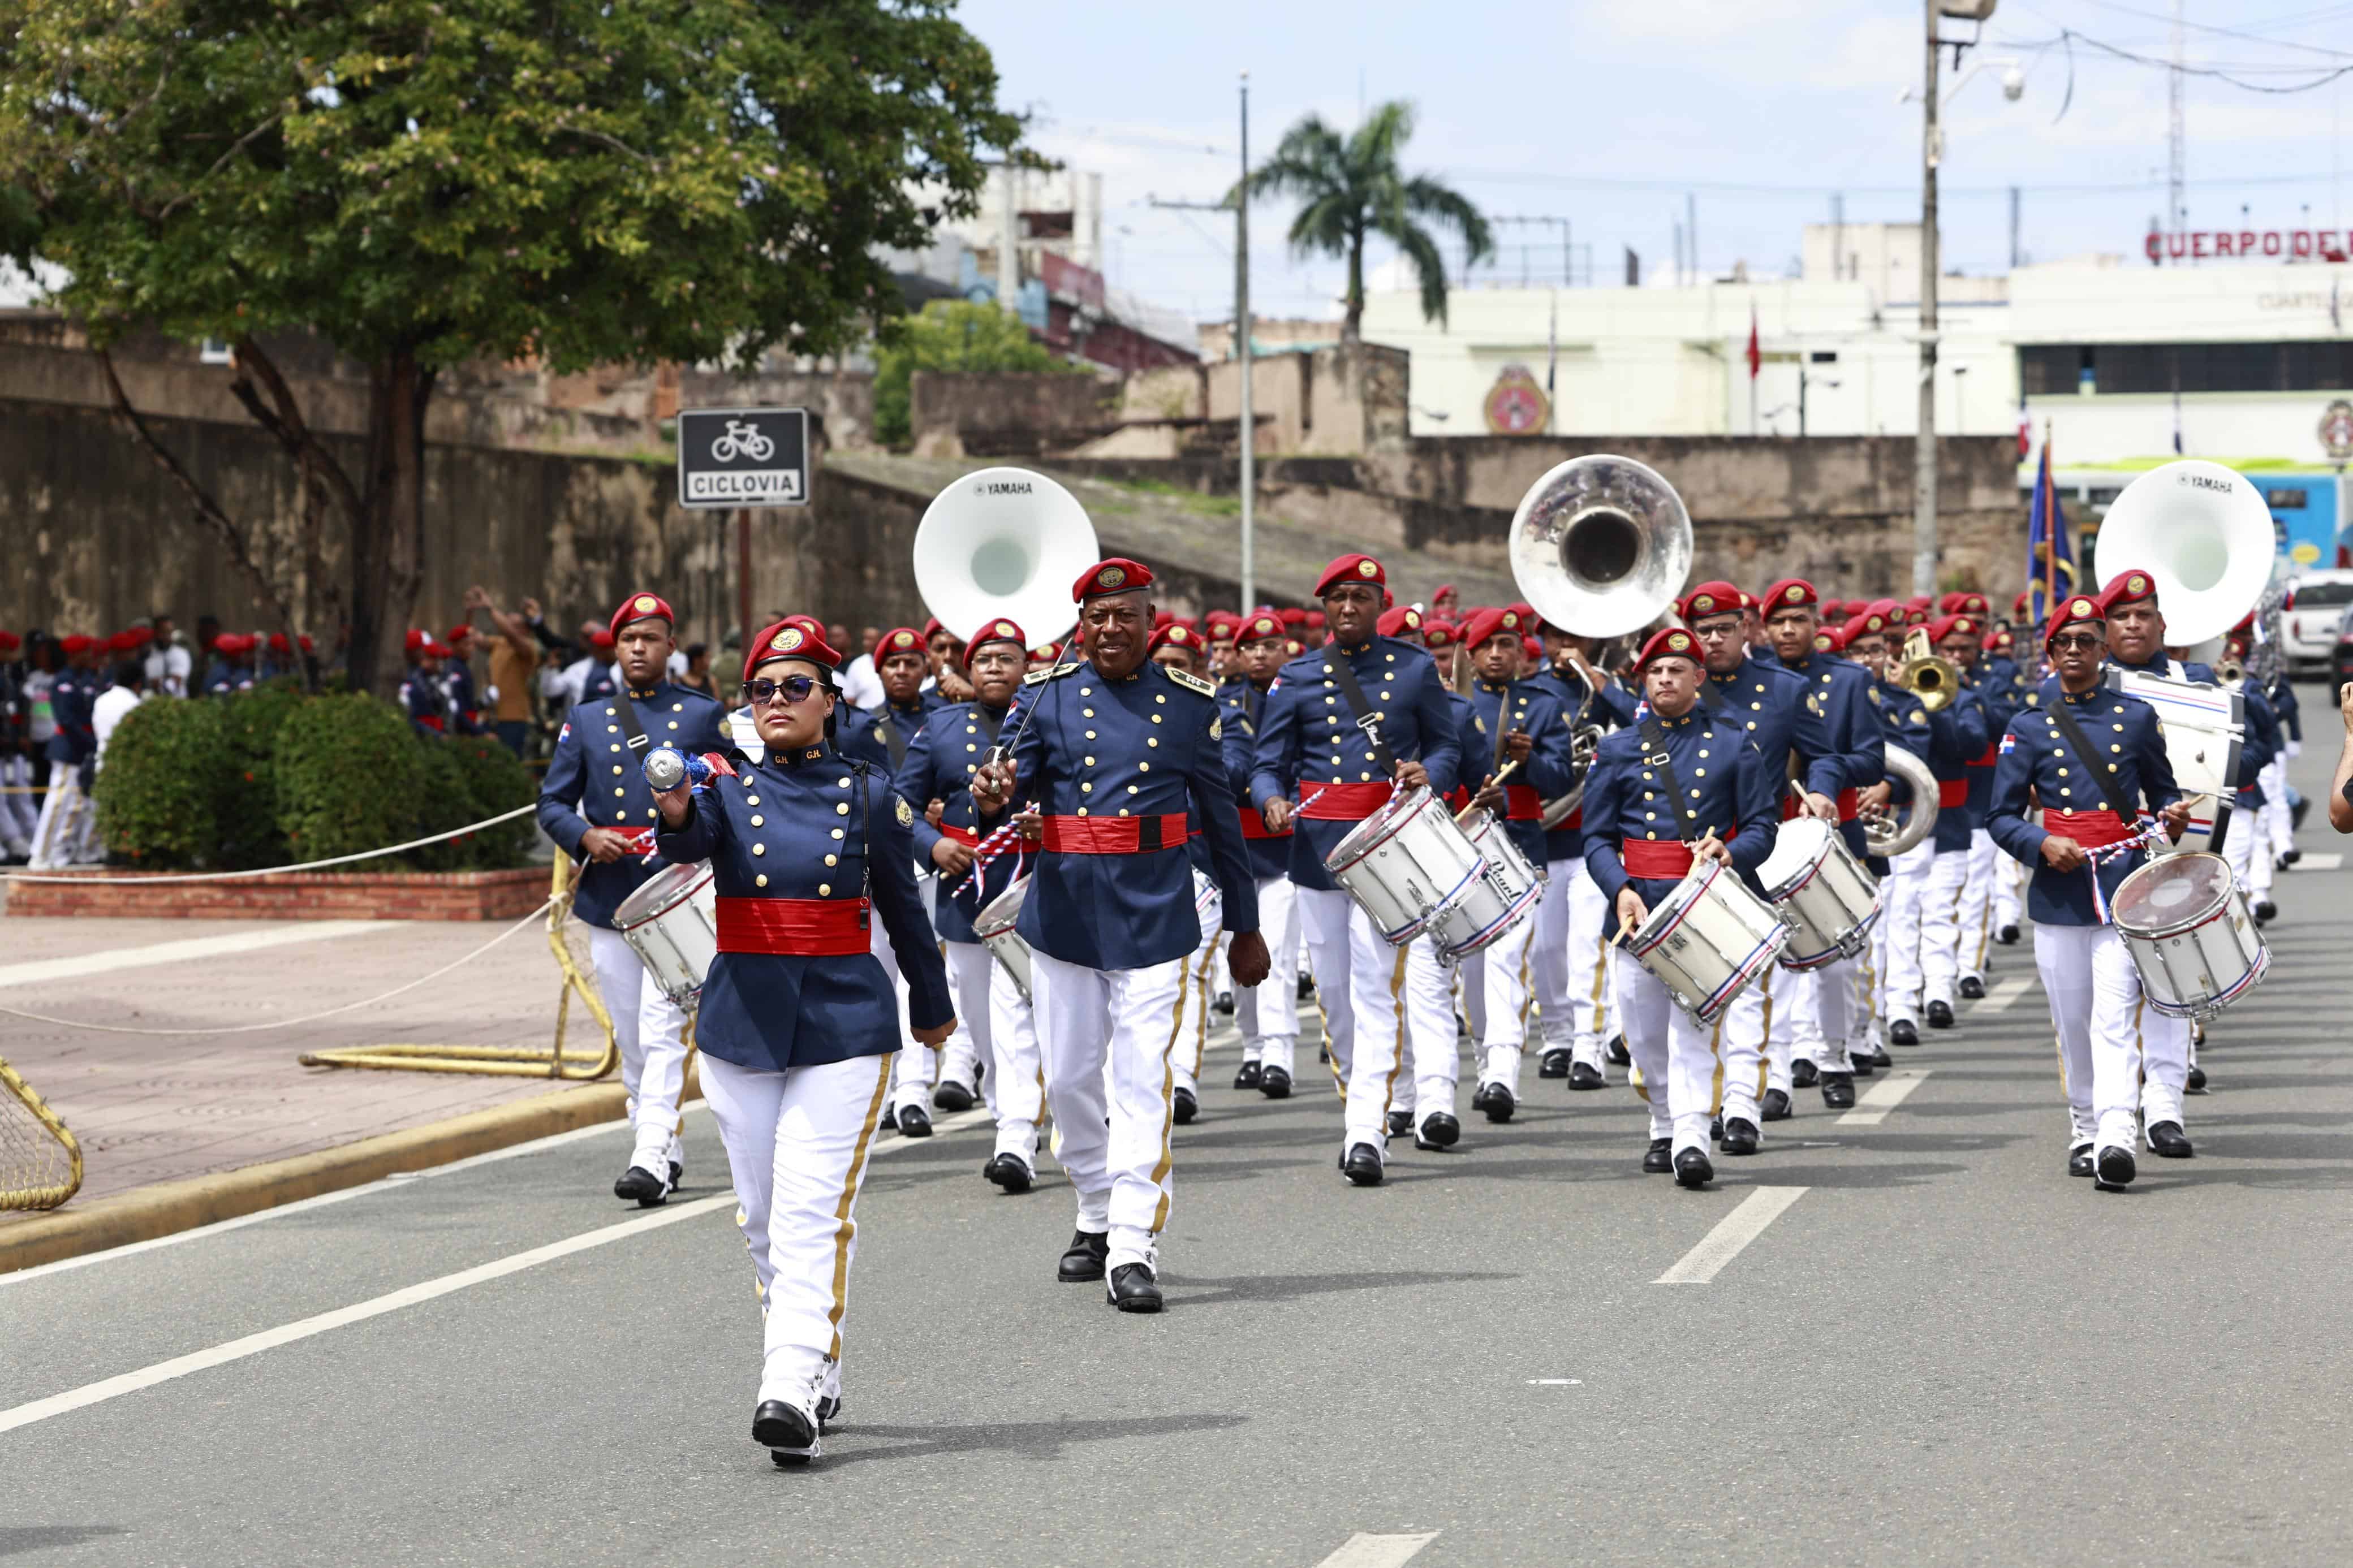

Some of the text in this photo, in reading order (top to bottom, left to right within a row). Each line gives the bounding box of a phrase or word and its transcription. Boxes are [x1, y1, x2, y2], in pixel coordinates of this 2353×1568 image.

[2145, 231, 2280, 258] CUERPO
[694, 474, 794, 494] CICLOVIA
[986, 482, 1033, 495] YAMAHA
[2192, 476, 2233, 494] YAMAHA
[775, 755, 788, 764] G.H.
[806, 749, 822, 759] G.H.
[1489, 855, 1523, 900] Pearl
